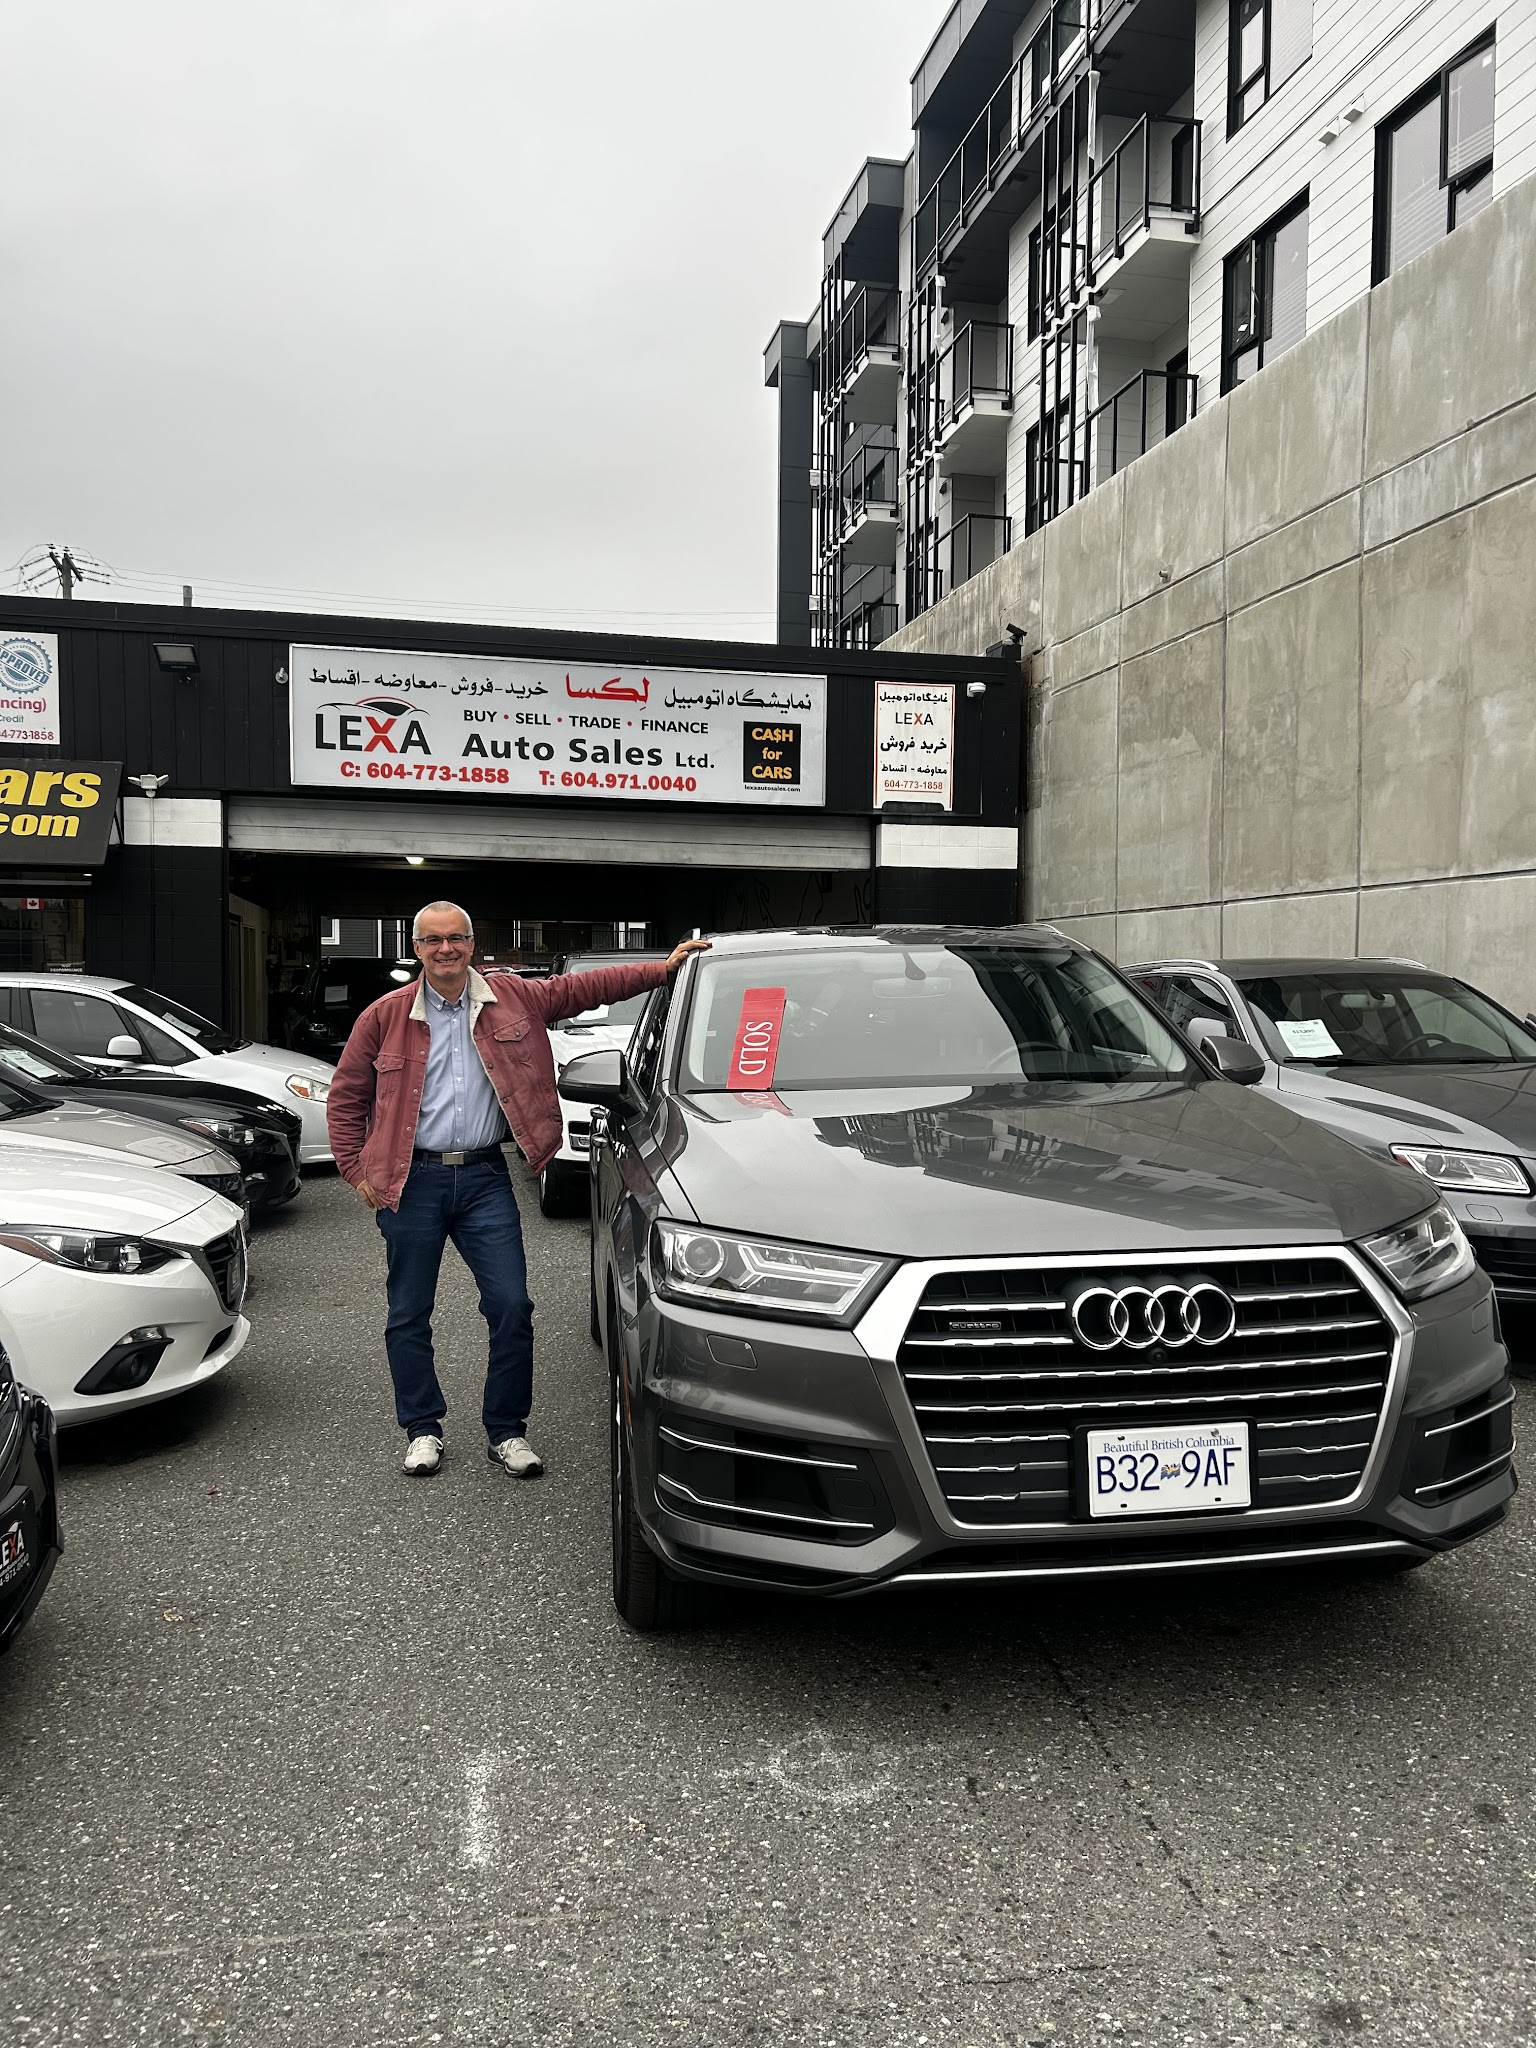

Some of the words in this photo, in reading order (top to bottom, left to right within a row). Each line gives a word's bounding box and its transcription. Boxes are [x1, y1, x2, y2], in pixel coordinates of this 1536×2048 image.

[0, 647, 50, 685] PPROVED
[664, 686, 724, 710] اتومبیل
[463, 709, 498, 723] BUY
[515, 712, 552, 726] SELL
[568, 715, 621, 730] TRADE
[641, 719, 709, 734] FINANCE
[895, 711, 934, 726] LEXA
[315, 713, 432, 755] LEXA
[462, 733, 555, 761] Auto
[568, 738, 663, 766] Sales
[675, 752, 715, 769] Ltd.
[880, 735, 915, 752] فروش
[920, 737, 947, 754] خرید
[762, 746, 783, 760] for
[340, 761, 361, 778] C:
[366, 762, 510, 784] 604-773-1858
[539, 770, 555, 786] T:
[561, 771, 697, 792] 604.971.0040
[751, 765, 793, 780] CARS
[744, 784, 802, 793] lexaautosales.com
[884, 779, 943, 791] 604-773-1858
[738, 1021, 773, 1075] SOLD
[1103, 1440, 1149, 1453] Beautiful
[1151, 1438, 1184, 1451] British
[1185, 1436, 1235, 1448] Columbia
